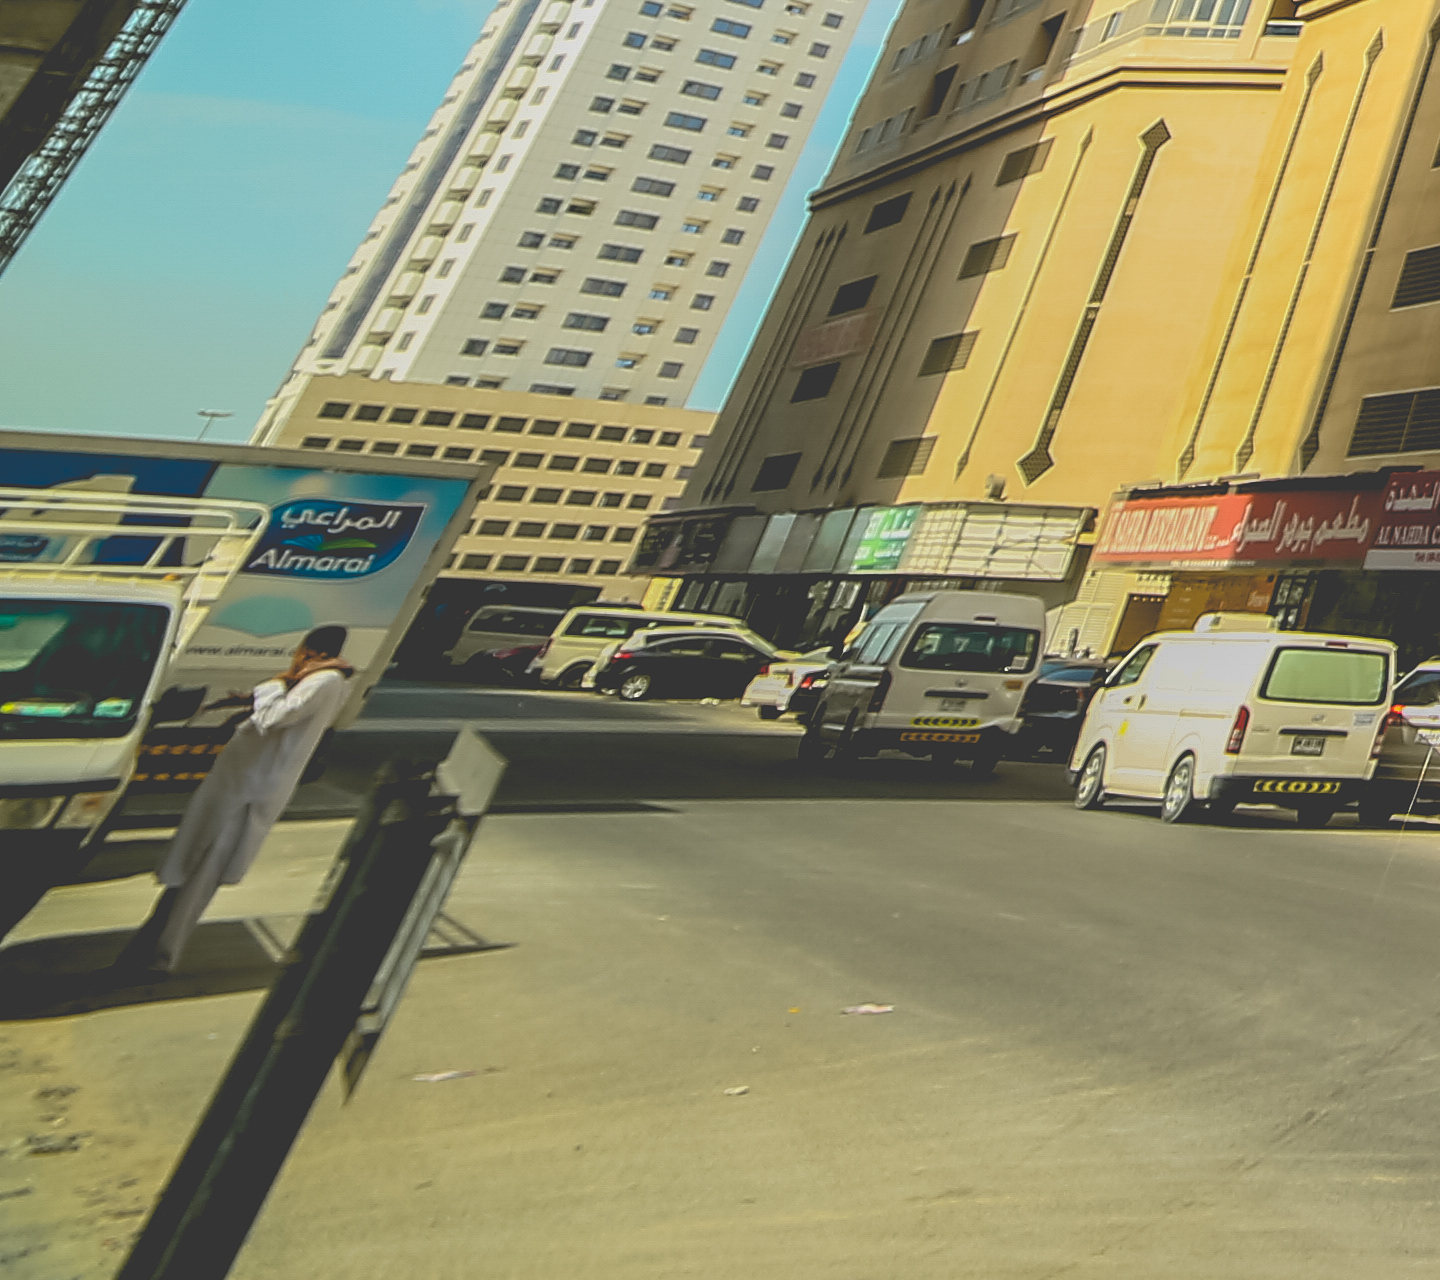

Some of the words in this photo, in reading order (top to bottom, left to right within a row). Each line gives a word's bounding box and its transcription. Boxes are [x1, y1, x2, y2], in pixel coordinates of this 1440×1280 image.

[281, 506, 403, 534] المراعي
[1375, 525, 1394, 545] AL
[1390, 525, 1430, 545] NAHDA
[249, 547, 377, 574] Almarai
